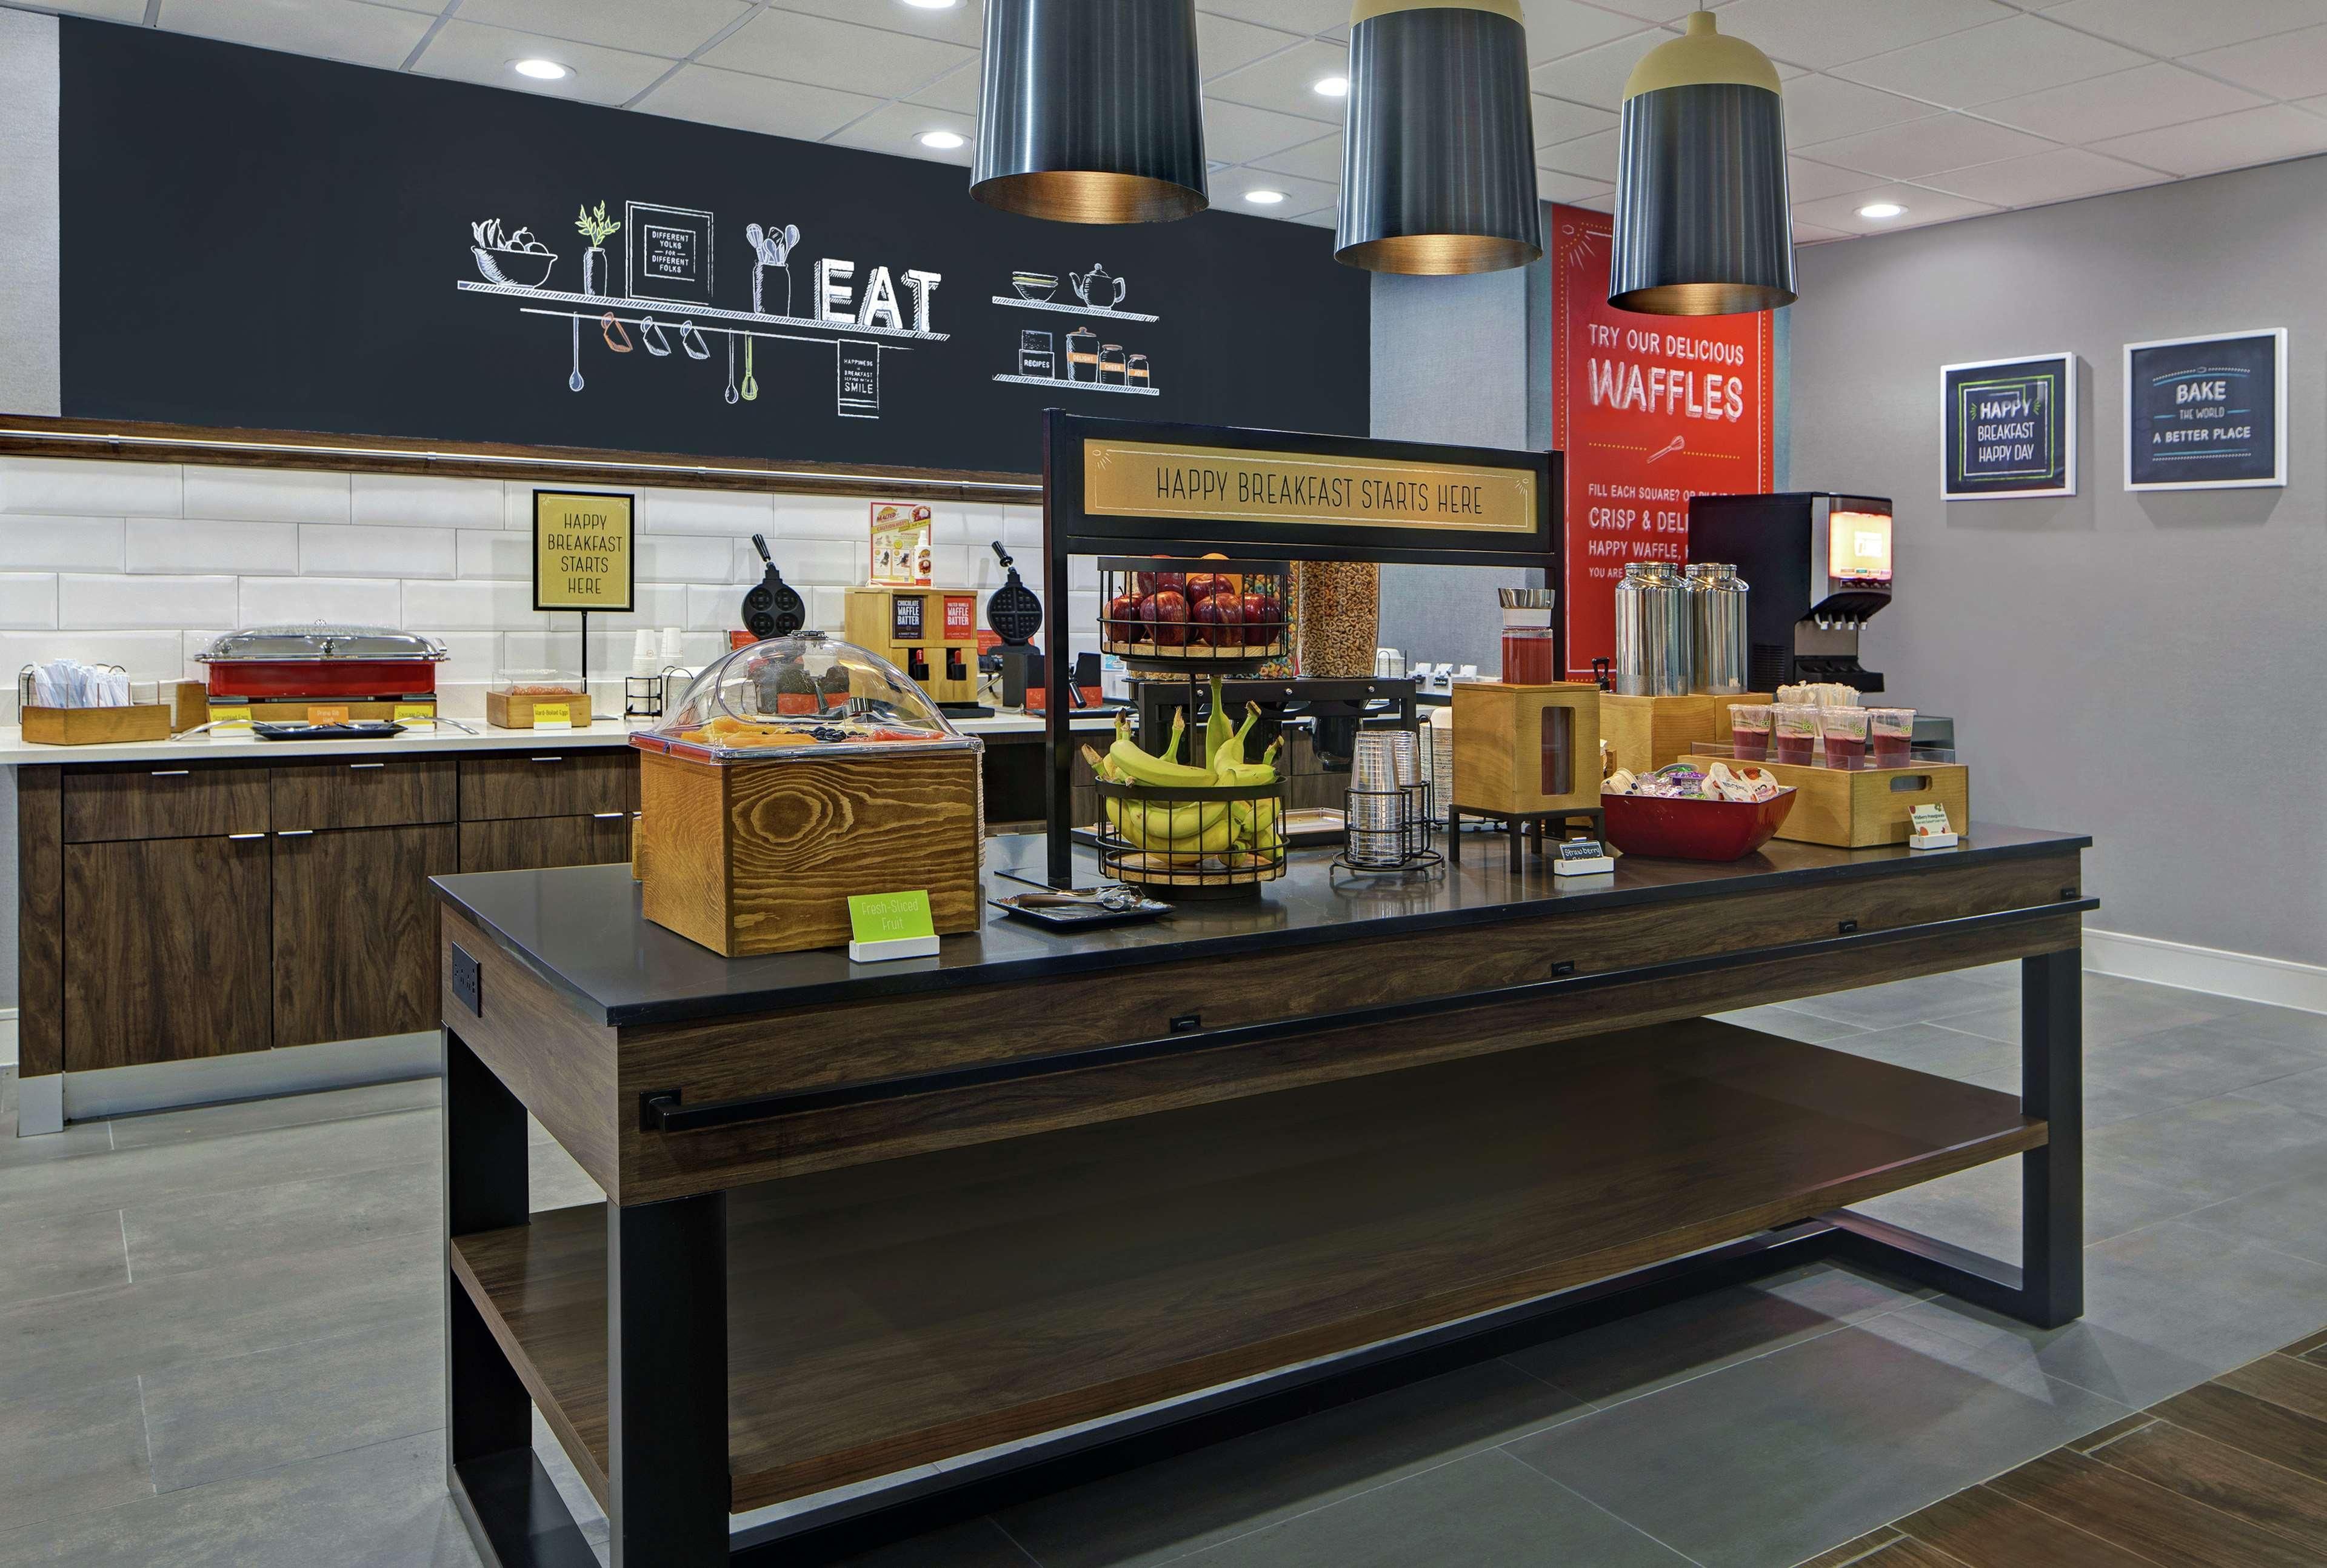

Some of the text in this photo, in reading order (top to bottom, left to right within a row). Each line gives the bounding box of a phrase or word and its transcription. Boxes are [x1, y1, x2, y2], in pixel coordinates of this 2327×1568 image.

[652, 231, 689, 242] DIFFERENT
[659, 240, 682, 249] YOLKS
[652, 255, 689, 266] DIFFERENT
[659, 264, 681, 273] FOLKS
[814, 258, 941, 332] EAT
[1588, 324, 1744, 366] TRY OUR DELICIOUS
[1024, 359, 1050, 369] RECIPES
[1073, 353, 1094, 362] DELIGHT
[844, 382, 873, 393] SMILE
[1588, 358, 1743, 422] WAFFLES
[2175, 381, 2226, 405] BAKE
[1980, 398, 2032, 420] HAPPY
[2179, 406, 2225, 421] THE WORLD
[1978, 422, 2035, 442] BREAKFAST
[2153, 425, 2251, 444] A BETTER PLACE
[1979, 443, 2034, 462] HAPPY DAY
[1157, 467, 1483, 514] HAPPY BREAKFAST STARTS HERE
[1589, 484, 1607, 497] FILL
[1611, 485, 1635, 499] EACH
[1638, 487, 1680, 502] SQUARE?
[564, 513, 607, 530] HAPPY
[1589, 507, 1635, 530] CRISP
[1641, 510, 1651, 532] &
[548, 533, 623, 552] BREAKFAST
[1589, 540, 1628, 556] HAPPY
[1633, 542, 1682, 560] WAFFLE,
[561, 556, 609, 573] STARTS
[1589, 567, 1623, 579] YOU ARE
[569, 578, 601, 594] HERE
[897, 607, 920, 616] WAFFLE
[947, 607, 969, 616] WAFFLE
[897, 616, 920, 626] BATTER
[947, 616, 969, 626] BATTER
[1564, 847, 1601, 857] Strawberry
[861, 898, 918, 916] Fresh-Sliced
[882, 916, 903, 931] Fruit
